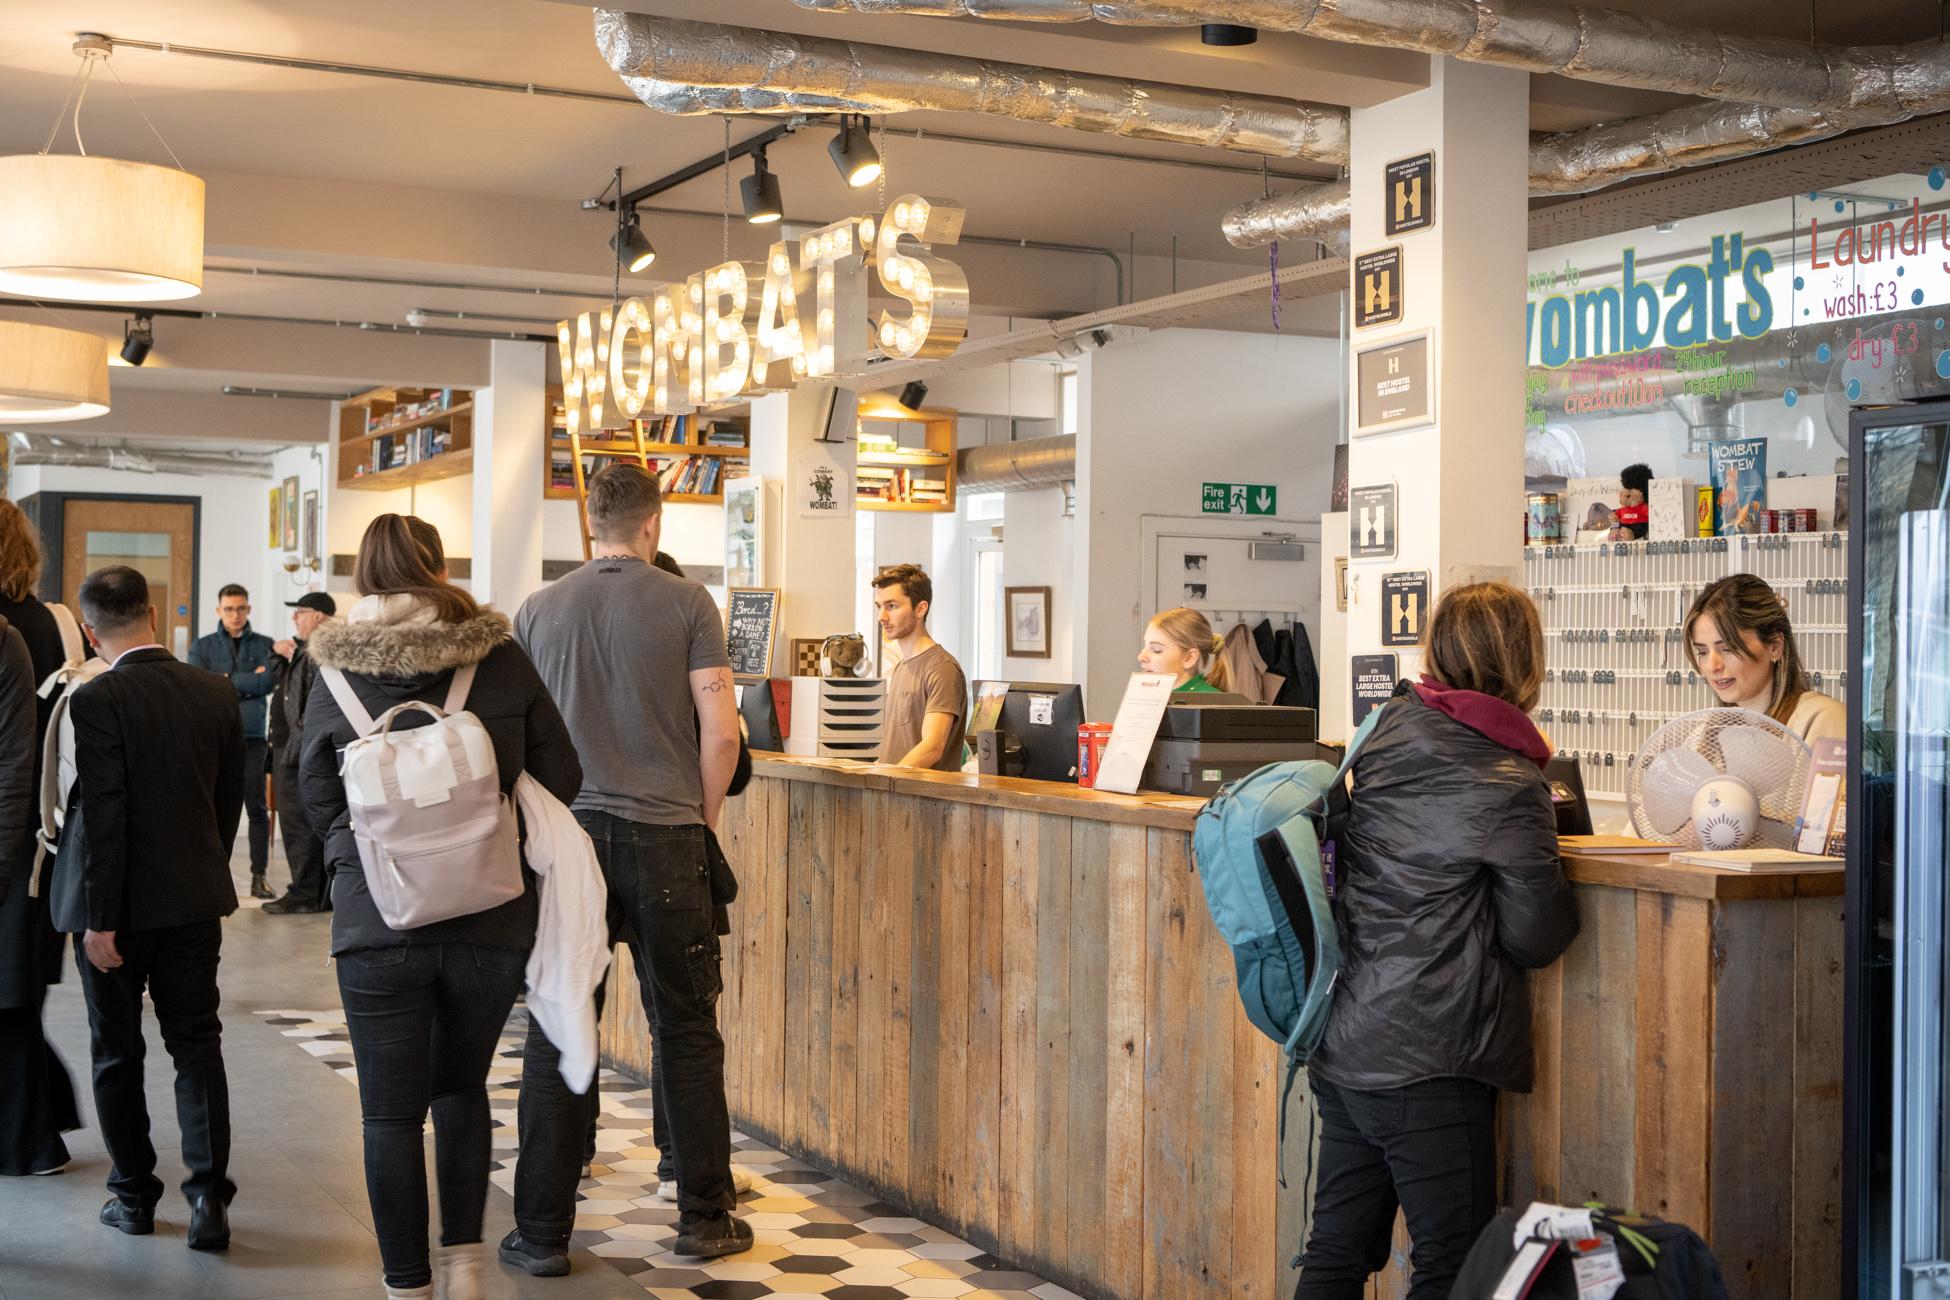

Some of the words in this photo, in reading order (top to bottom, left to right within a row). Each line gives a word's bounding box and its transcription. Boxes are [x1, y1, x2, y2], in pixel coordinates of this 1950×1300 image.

[1528, 271, 1557, 293] ome
[1564, 259, 1580, 287] to
[1377, 380, 1390, 390] BEST
[1390, 376, 1411, 387] HOSTEL
[1711, 442, 1764, 458] WOMBAT
[1718, 457, 1756, 472] STEW
[1204, 486, 1224, 498] Fire
[1600, 484, 1620, 495] Womb
[809, 501, 838, 510] WOMBAT!
[1204, 499, 1224, 510] exit
[741, 624, 765, 632] BORROW
[1359, 674, 1372, 682] BEST
[1372, 674, 1391, 682] EXTRA
[1373, 682, 1394, 690] HOSTEL
[1358, 690, 1393, 698] WORLDWIDE
